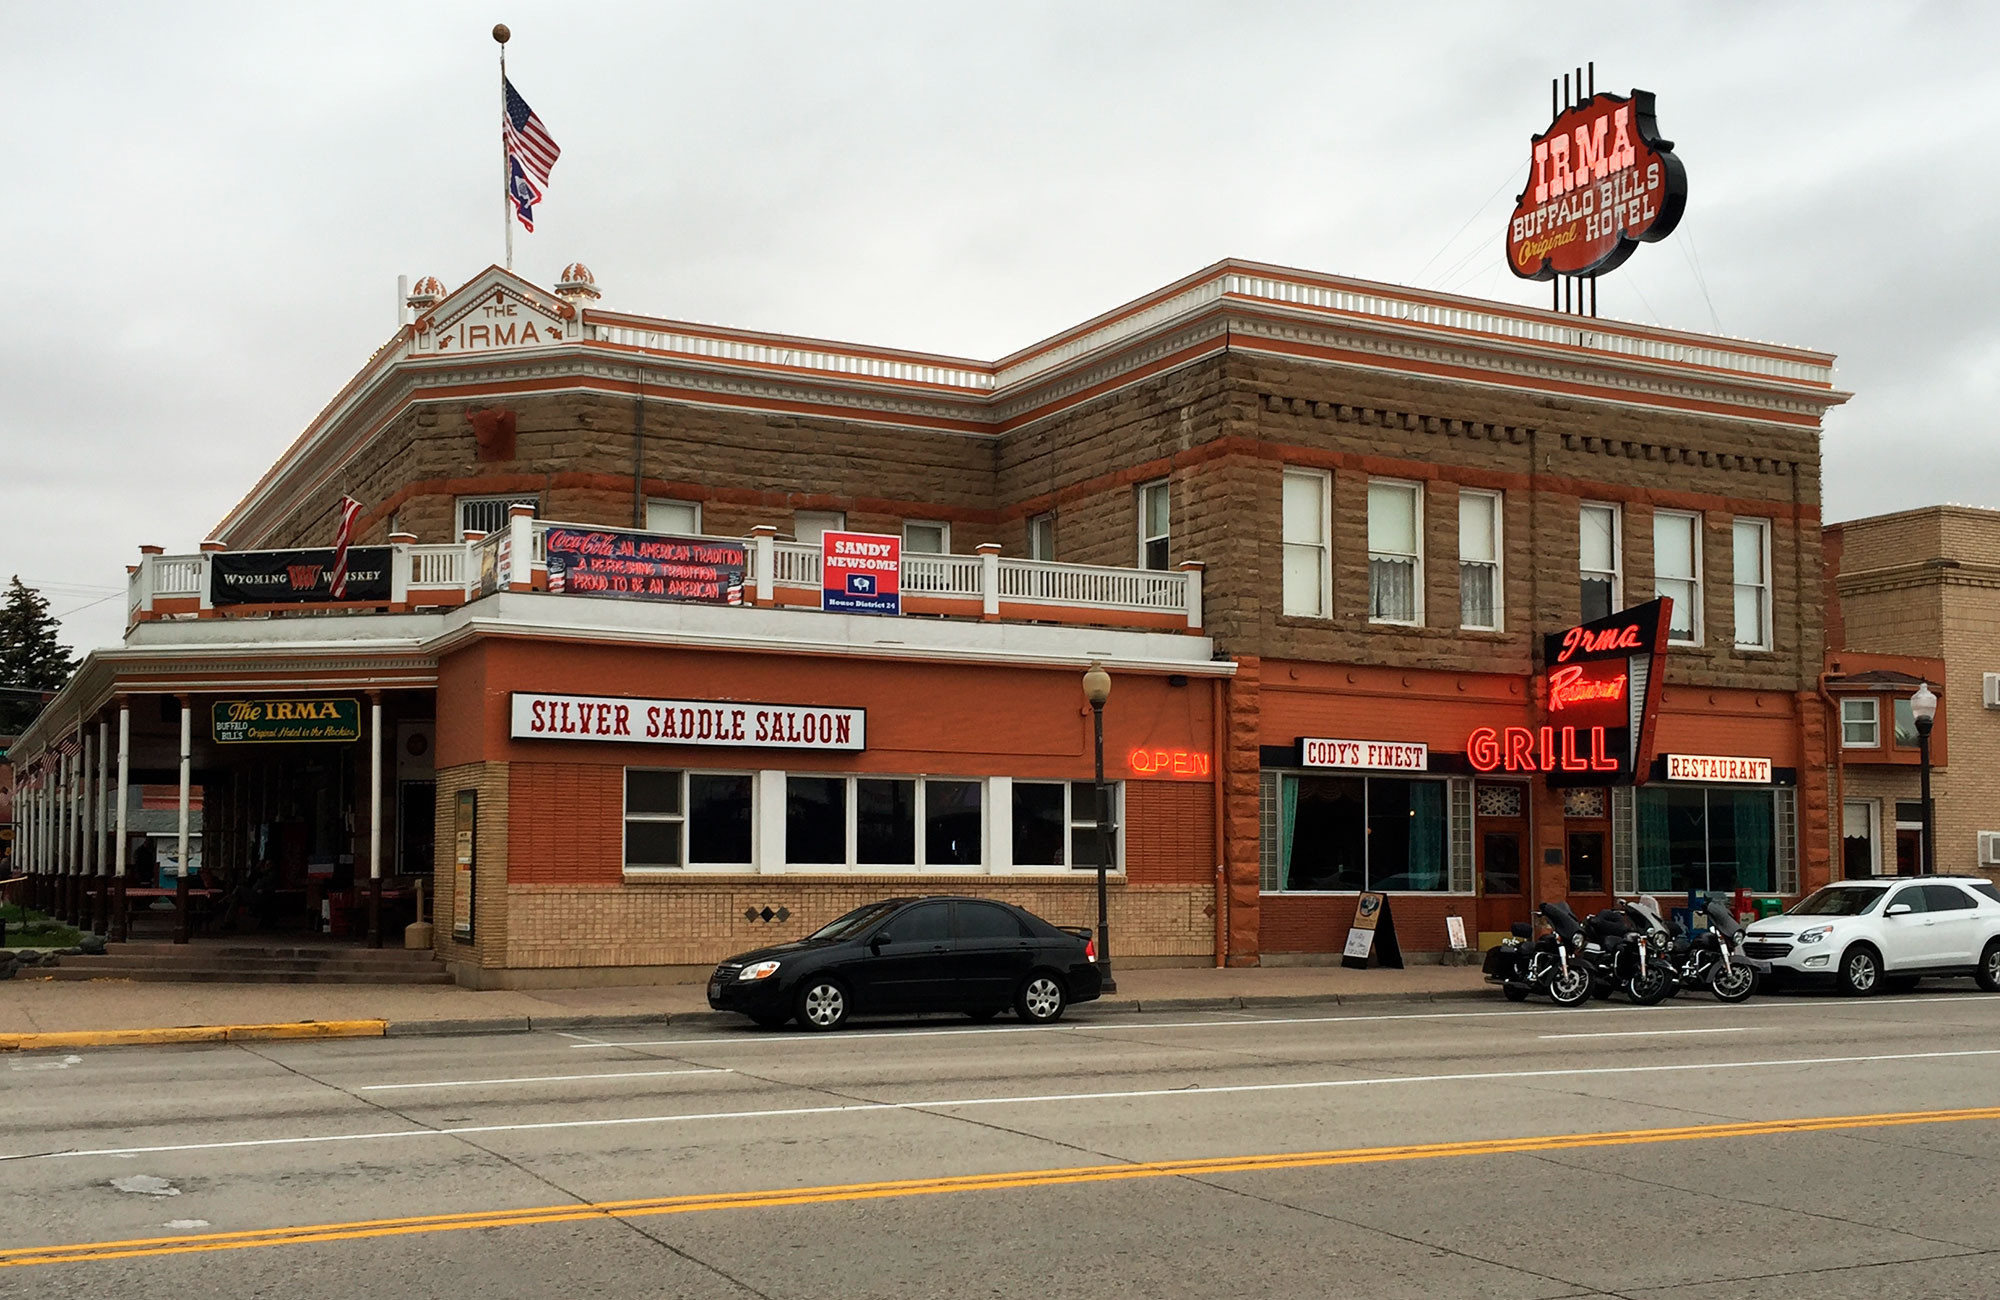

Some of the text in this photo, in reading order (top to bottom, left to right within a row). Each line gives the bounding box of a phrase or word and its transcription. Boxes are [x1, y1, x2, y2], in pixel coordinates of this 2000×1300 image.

[1535, 106, 1636, 204] IRMA
[1513, 162, 1660, 243] BUFFALO BILLS
[1518, 194, 1655, 266] Original HOTEL
[483, 304, 518, 318] THE
[460, 321, 540, 348] IRMA
[548, 529, 618, 555] Coca-Cola
[638, 541, 689, 562] AMERICAN
[693, 545, 744, 566] TRADITION
[835, 541, 891, 557] SANDY
[591, 557, 656, 576] REFRESHING
[661, 563, 717, 580] TRADITION
[827, 556, 898, 571] NEWSOME
[224, 573, 287, 586] WYOMING
[322, 570, 381, 583] WISKEY
[574, 572, 608, 591] PROUD
[612, 575, 628, 592] TO
[631, 577, 645, 593] BE
[649, 578, 664, 594] AN
[668, 580, 719, 598] AMERICAN
[829, 599, 854, 607] House
[856, 600, 885, 609] District
[1557, 624, 1643, 662] Irma
[1549, 665, 1628, 712] Restaurant
[228, 700, 341, 722] The IRMA
[531, 700, 852, 744] SILVER SADDLE SALOON
[216, 721, 248, 731] BUFFALO
[248, 725, 355, 740] Original Hotel in the Rockies
[1308, 742, 1423, 767] CODY'S FINEST
[1467, 726, 1618, 771] GRILL
[1131, 750, 1208, 774] OPEN
[1671, 758, 1767, 780] RESTAURANT
